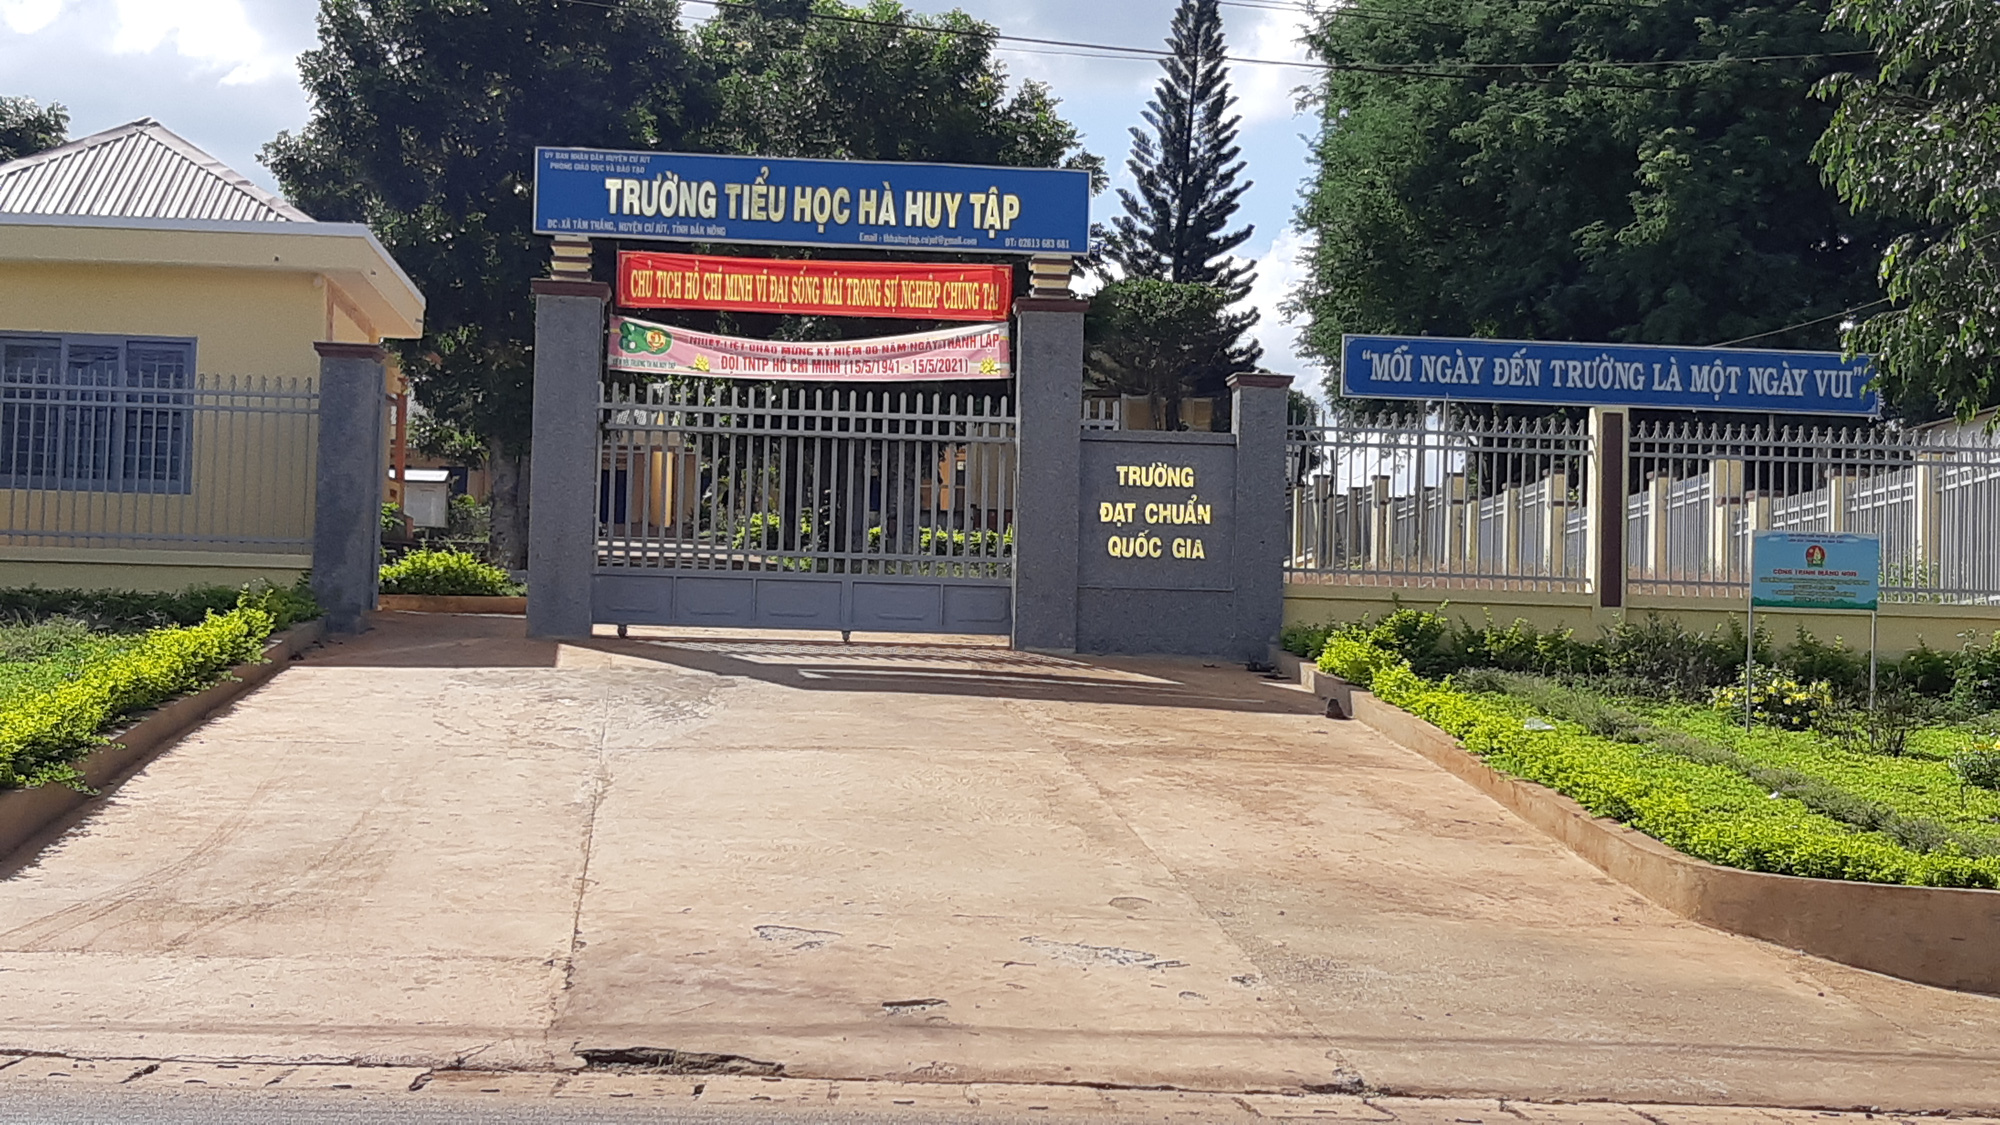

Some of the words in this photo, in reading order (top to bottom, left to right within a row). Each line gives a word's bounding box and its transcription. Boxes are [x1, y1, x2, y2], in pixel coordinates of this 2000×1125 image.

[605, 170, 717, 218] TRƯỜNG
[724, 166, 787, 222] TIỂU
[793, 186, 850, 234] HỌC
[858, 181, 897, 226] HÀ
[905, 190, 963, 229] HUY
[969, 186, 1020, 239] TẬP
[572, 218, 588, 230] TÂM
[619, 220, 642, 234] HUYỆN
[672, 221, 688, 234] TỈNH
[706, 224, 726, 236] NÔNG
[631, 259, 652, 298] CHỦ
[656, 271, 682, 304] TỊCH
[685, 260, 700, 300] HỒ
[703, 265, 723, 301] CHÍ
[724, 274, 754, 302] MINH
[755, 268, 768, 303] VĨ
[769, 274, 789, 309] ĐẠI
[792, 266, 820, 305] SỐNG
[822, 271, 843, 306] MÃI
[846, 278, 881, 307] TRONG
[884, 275, 900, 313] SỰ
[900, 274, 941, 313] NGHIỆP
[943, 274, 979, 310] CHÚNG
[982, 282, 1000, 310] TA!
[942, 334, 976, 350] THÀNH
[980, 330, 1000, 352] LẬP
[720, 352, 738, 374] ĐỘI
[742, 356, 769, 372] TNTP
[772, 356, 787, 373] HỒ
[790, 358, 808, 374] CHÍ
[812, 360, 840, 374] MINH
[844, 360, 900, 376] (15/5/1941
[912, 358, 968, 374] 15/5/2021)
[1419, 348, 1485, 385] NGÀY
[1492, 348, 1542, 387] ĐẾN
[1550, 353, 1645, 391] TRƯỜNG
[1652, 356, 1682, 392] LÀ
[1690, 358, 1742, 402] MỘT
[1748, 360, 1808, 397] NGÀY
[1814, 366, 1862, 398] VUI”
[1116, 462, 1194, 488] TRƯỜNG
[1100, 502, 1136, 528] ĐẠT
[1144, 494, 1212, 525] CHUẨN
[1108, 529, 1162, 558] QUỐC
[1172, 538, 1206, 560] GIA
